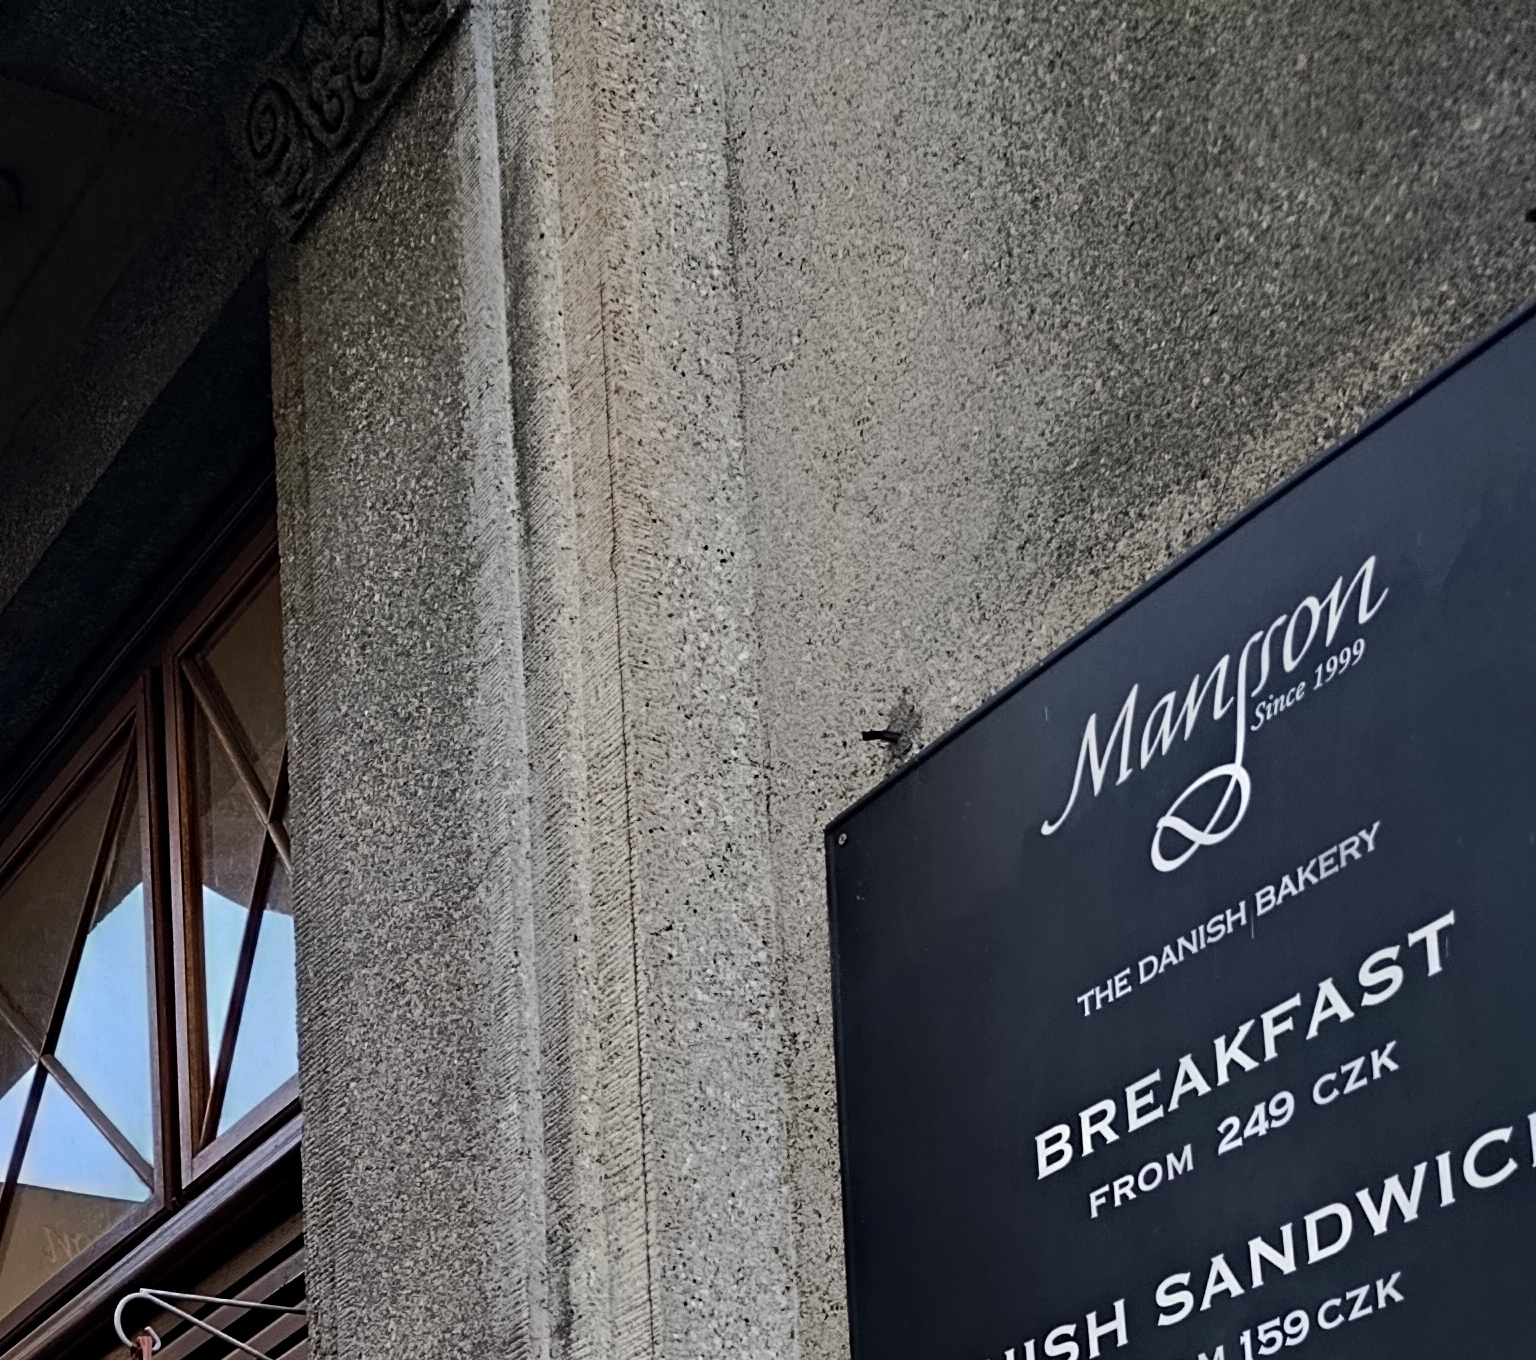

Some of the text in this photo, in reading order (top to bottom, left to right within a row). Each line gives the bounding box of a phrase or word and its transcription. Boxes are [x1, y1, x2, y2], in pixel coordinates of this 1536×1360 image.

[1250, 638, 1366, 731] Since 1999
[1076, 820, 1381, 1017] THE DANISH BAKERY
[1034, 909, 1456, 1181] BREAKFAST
[1088, 1040, 1400, 1219] FROM 249 CZK
[1155, 1112, 1536, 1327] SANDWIC
[1317, 1271, 1405, 1330] CZK
